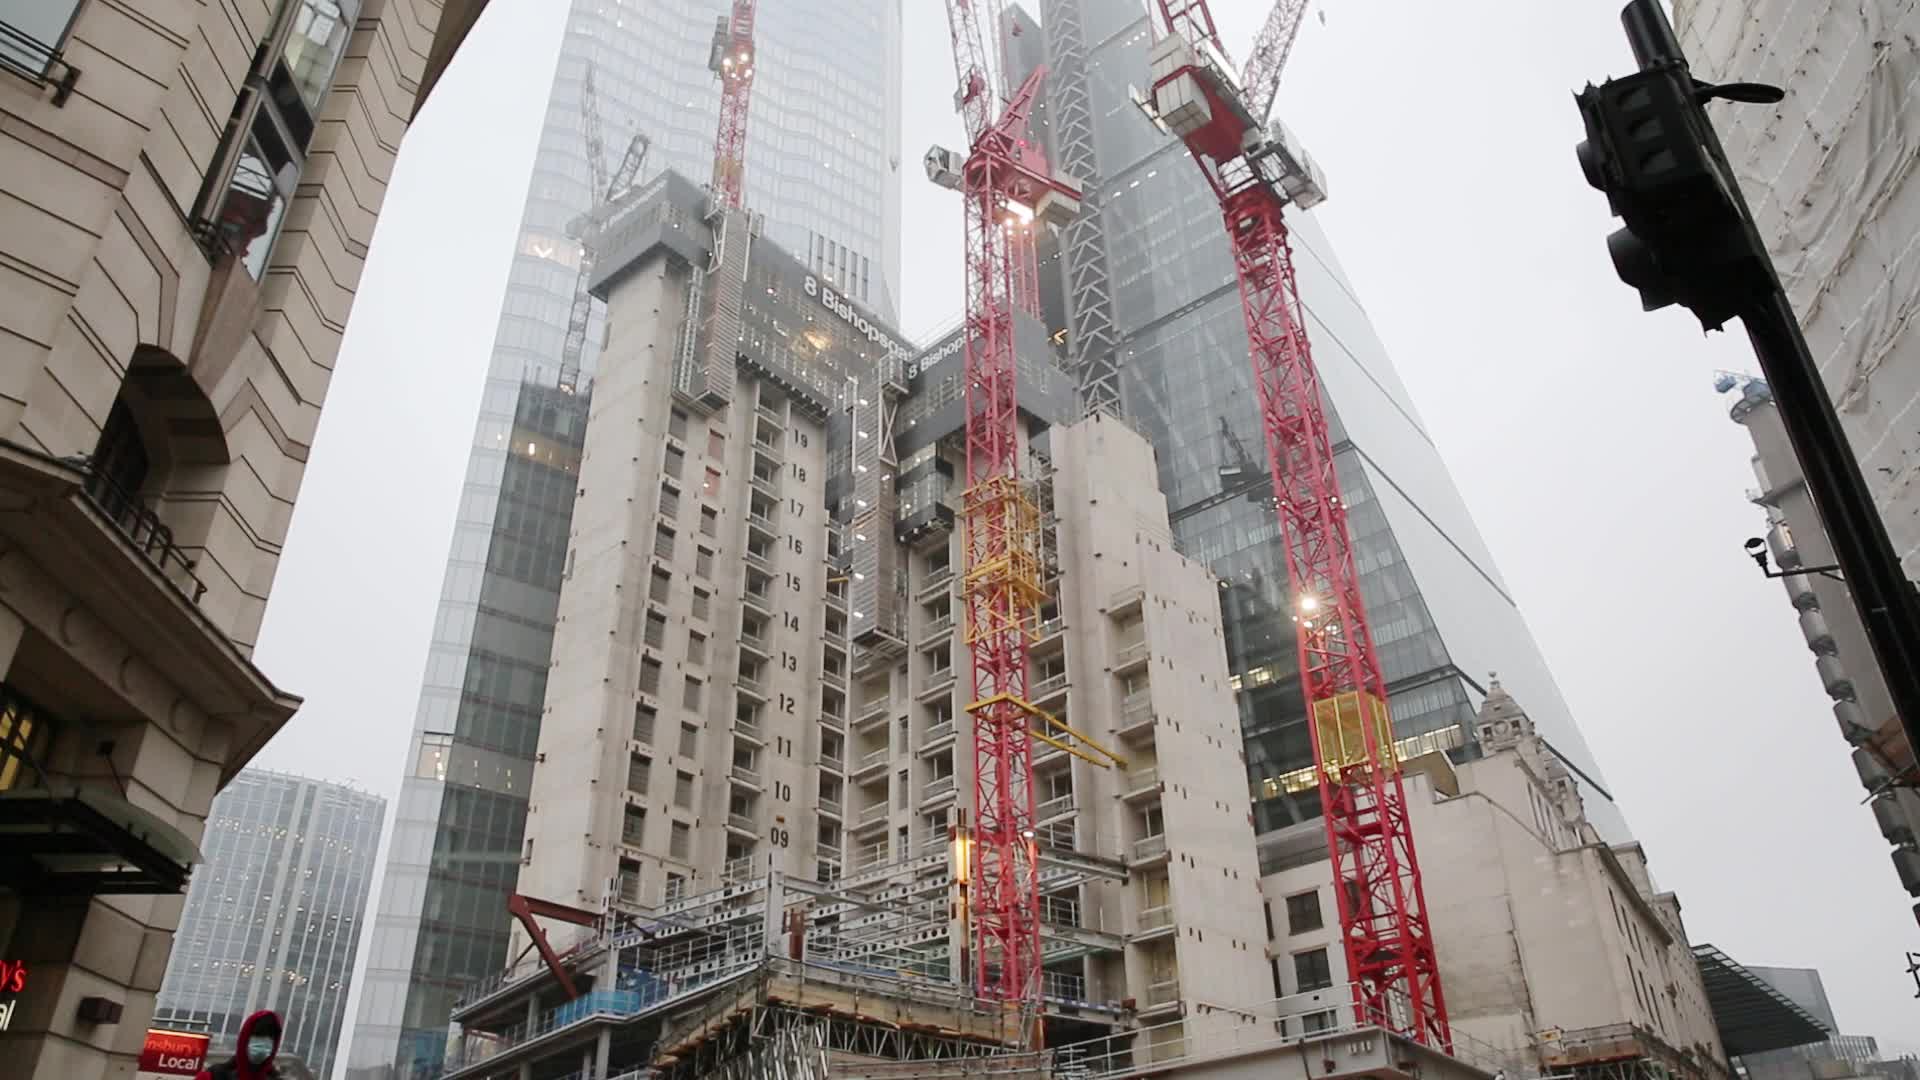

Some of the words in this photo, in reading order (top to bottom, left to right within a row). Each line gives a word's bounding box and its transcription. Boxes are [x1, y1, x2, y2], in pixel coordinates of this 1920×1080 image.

[804, 275, 818, 297] 8
[908, 363, 918, 380] 8
[794, 429, 808, 448] 19
[792, 463, 806, 482] 18
[791, 498, 804, 518] 17
[788, 535, 802, 554] 16
[786, 572, 801, 592] 15
[784, 611, 799, 632] 14
[782, 651, 797, 672] 13
[779, 692, 795, 715] 12
[777, 736, 791, 758] 11
[775, 780, 791, 803] 10
[770, 826, 789, 849] 09
[158, 1053, 200, 1070] Local
